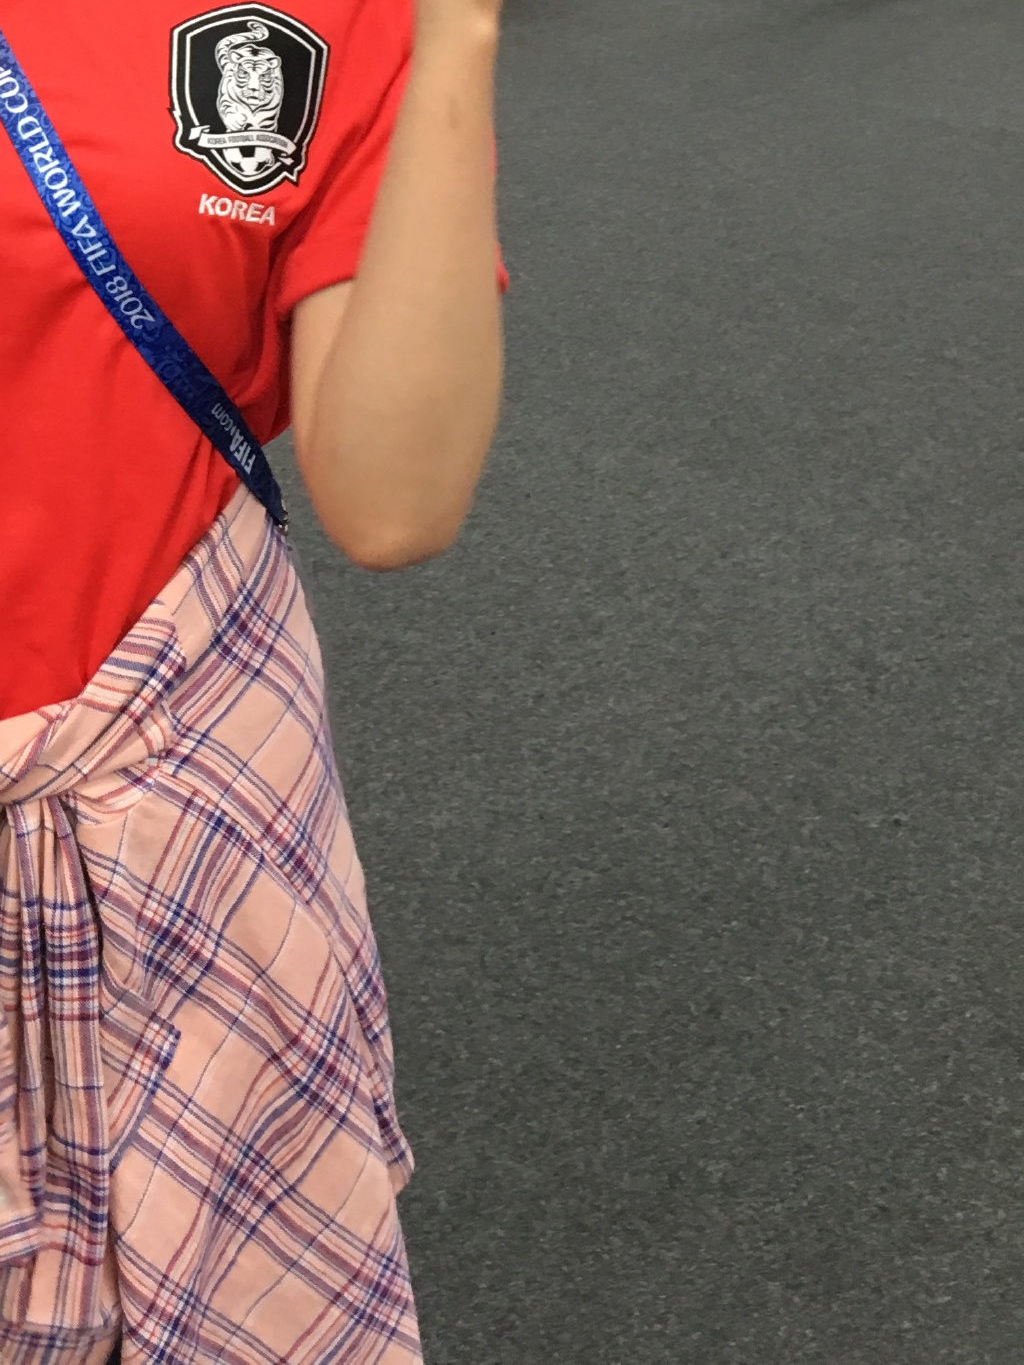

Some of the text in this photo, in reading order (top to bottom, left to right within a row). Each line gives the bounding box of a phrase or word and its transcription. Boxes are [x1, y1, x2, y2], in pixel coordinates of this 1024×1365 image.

[17, 116, 81, 217] WORLD
[198, 193, 276, 226] KOREA
[71, 215, 116, 276] FIFA
[105, 275, 156, 329] 2018
